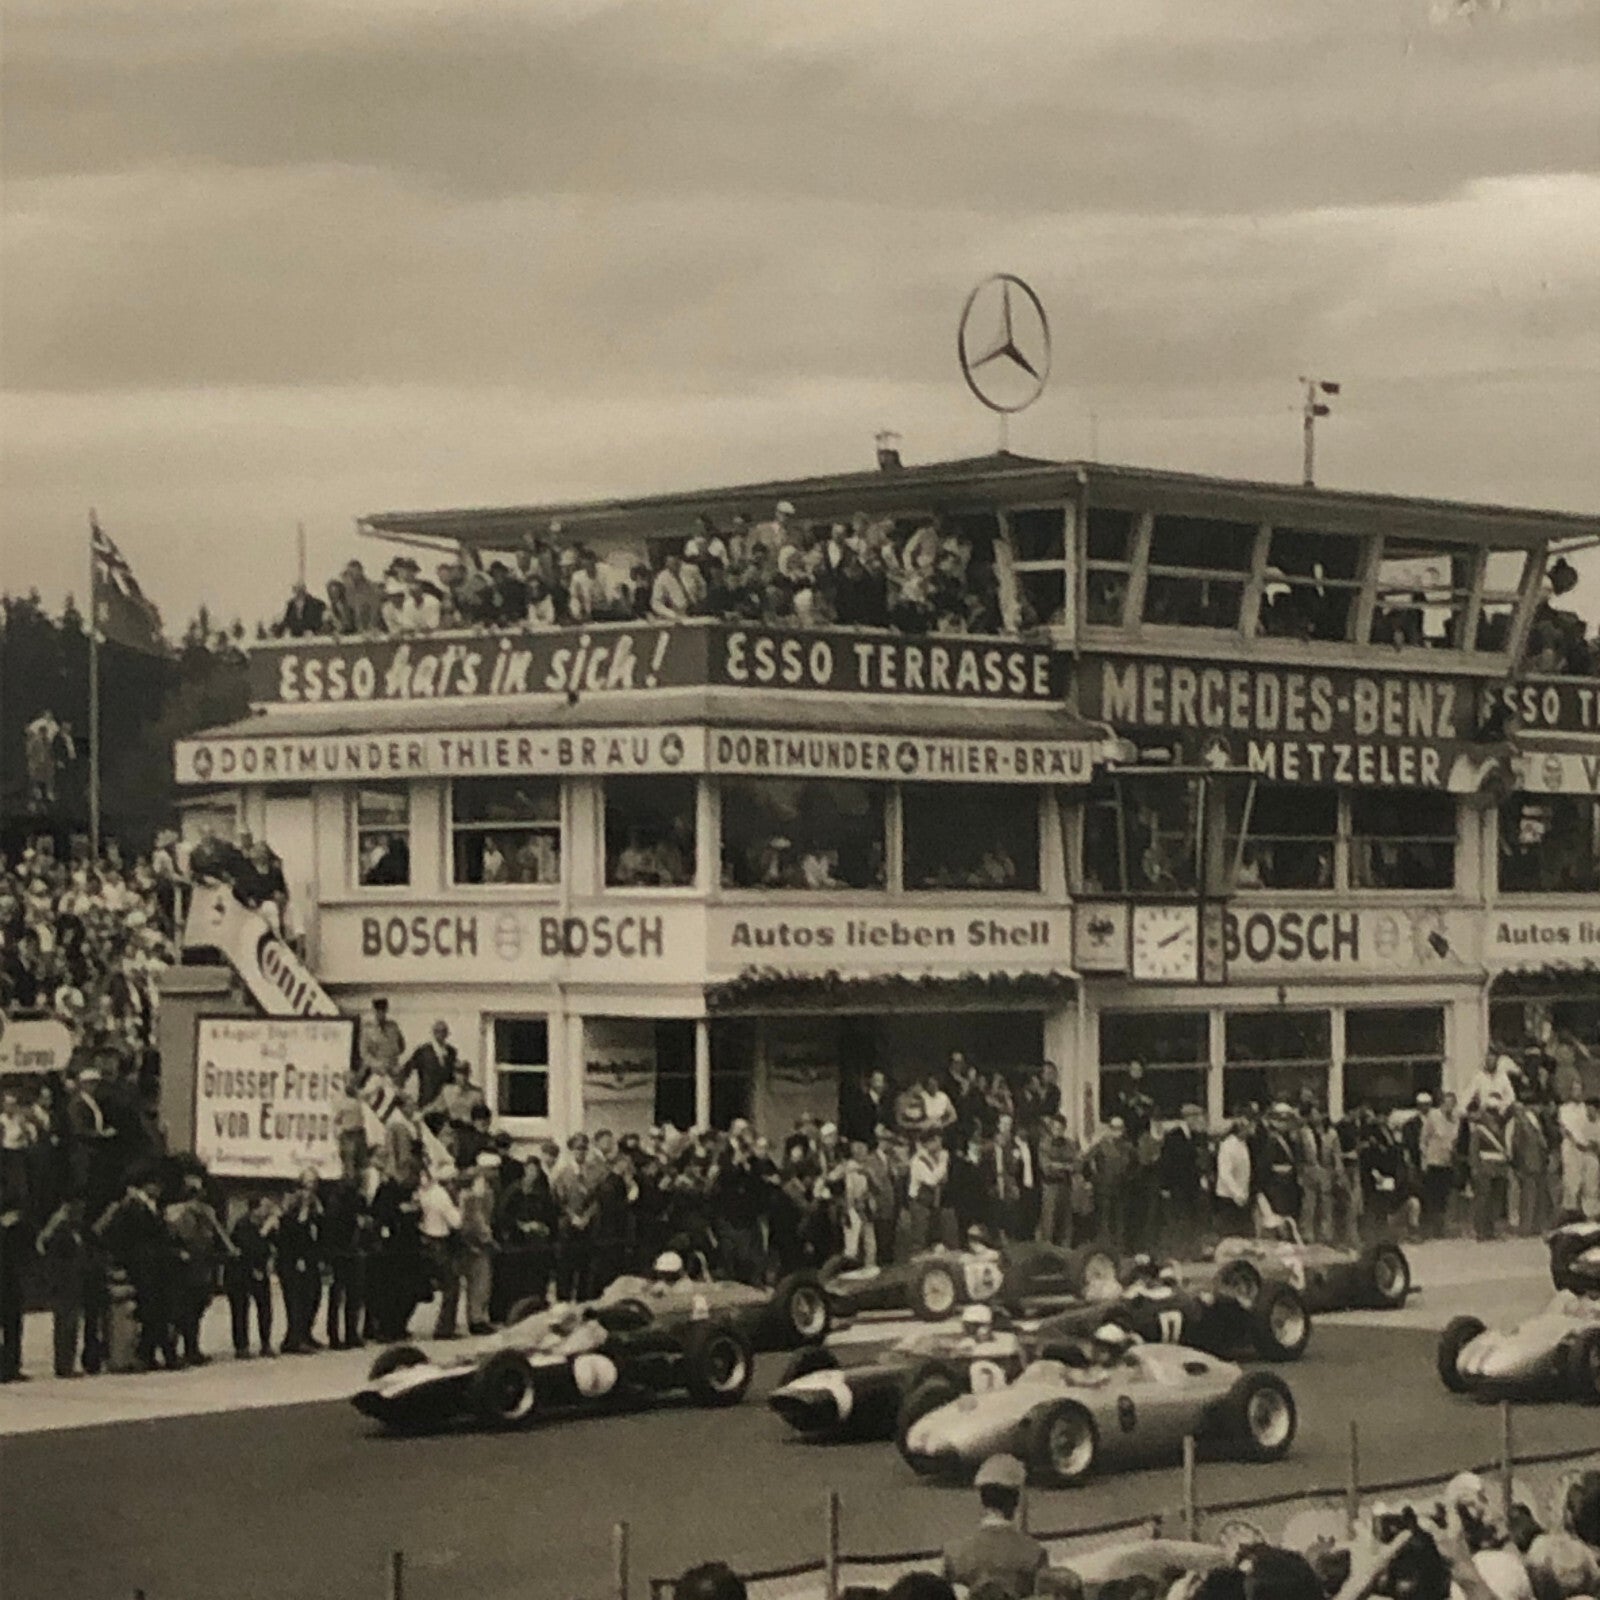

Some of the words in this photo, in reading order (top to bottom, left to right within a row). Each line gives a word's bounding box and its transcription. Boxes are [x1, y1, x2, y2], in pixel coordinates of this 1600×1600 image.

[279, 654, 376, 701] ESSO
[489, 637, 533, 694] in
[726, 632, 833, 684] ESSO
[854, 642, 1052, 695] TERRASSE
[1577, 689, 1600, 727] T
[221, 739, 423, 774] DORTMUNDER
[440, 736, 650, 769] THIER-BRÄU
[717, 735, 891, 771] DORTMUNDER
[925, 744, 1084, 775] THIER-BRÄU
[1246, 739, 1441, 787] METZELER
[362, 916, 478, 956] BOSCH
[539, 915, 664, 956] BOSCH
[731, 922, 834, 947] Autos
[847, 920, 956, 947] lieben
[967, 920, 1051, 947] Shell
[1224, 911, 1360, 962] BOSCH
[1496, 922, 1570, 945] Autos
